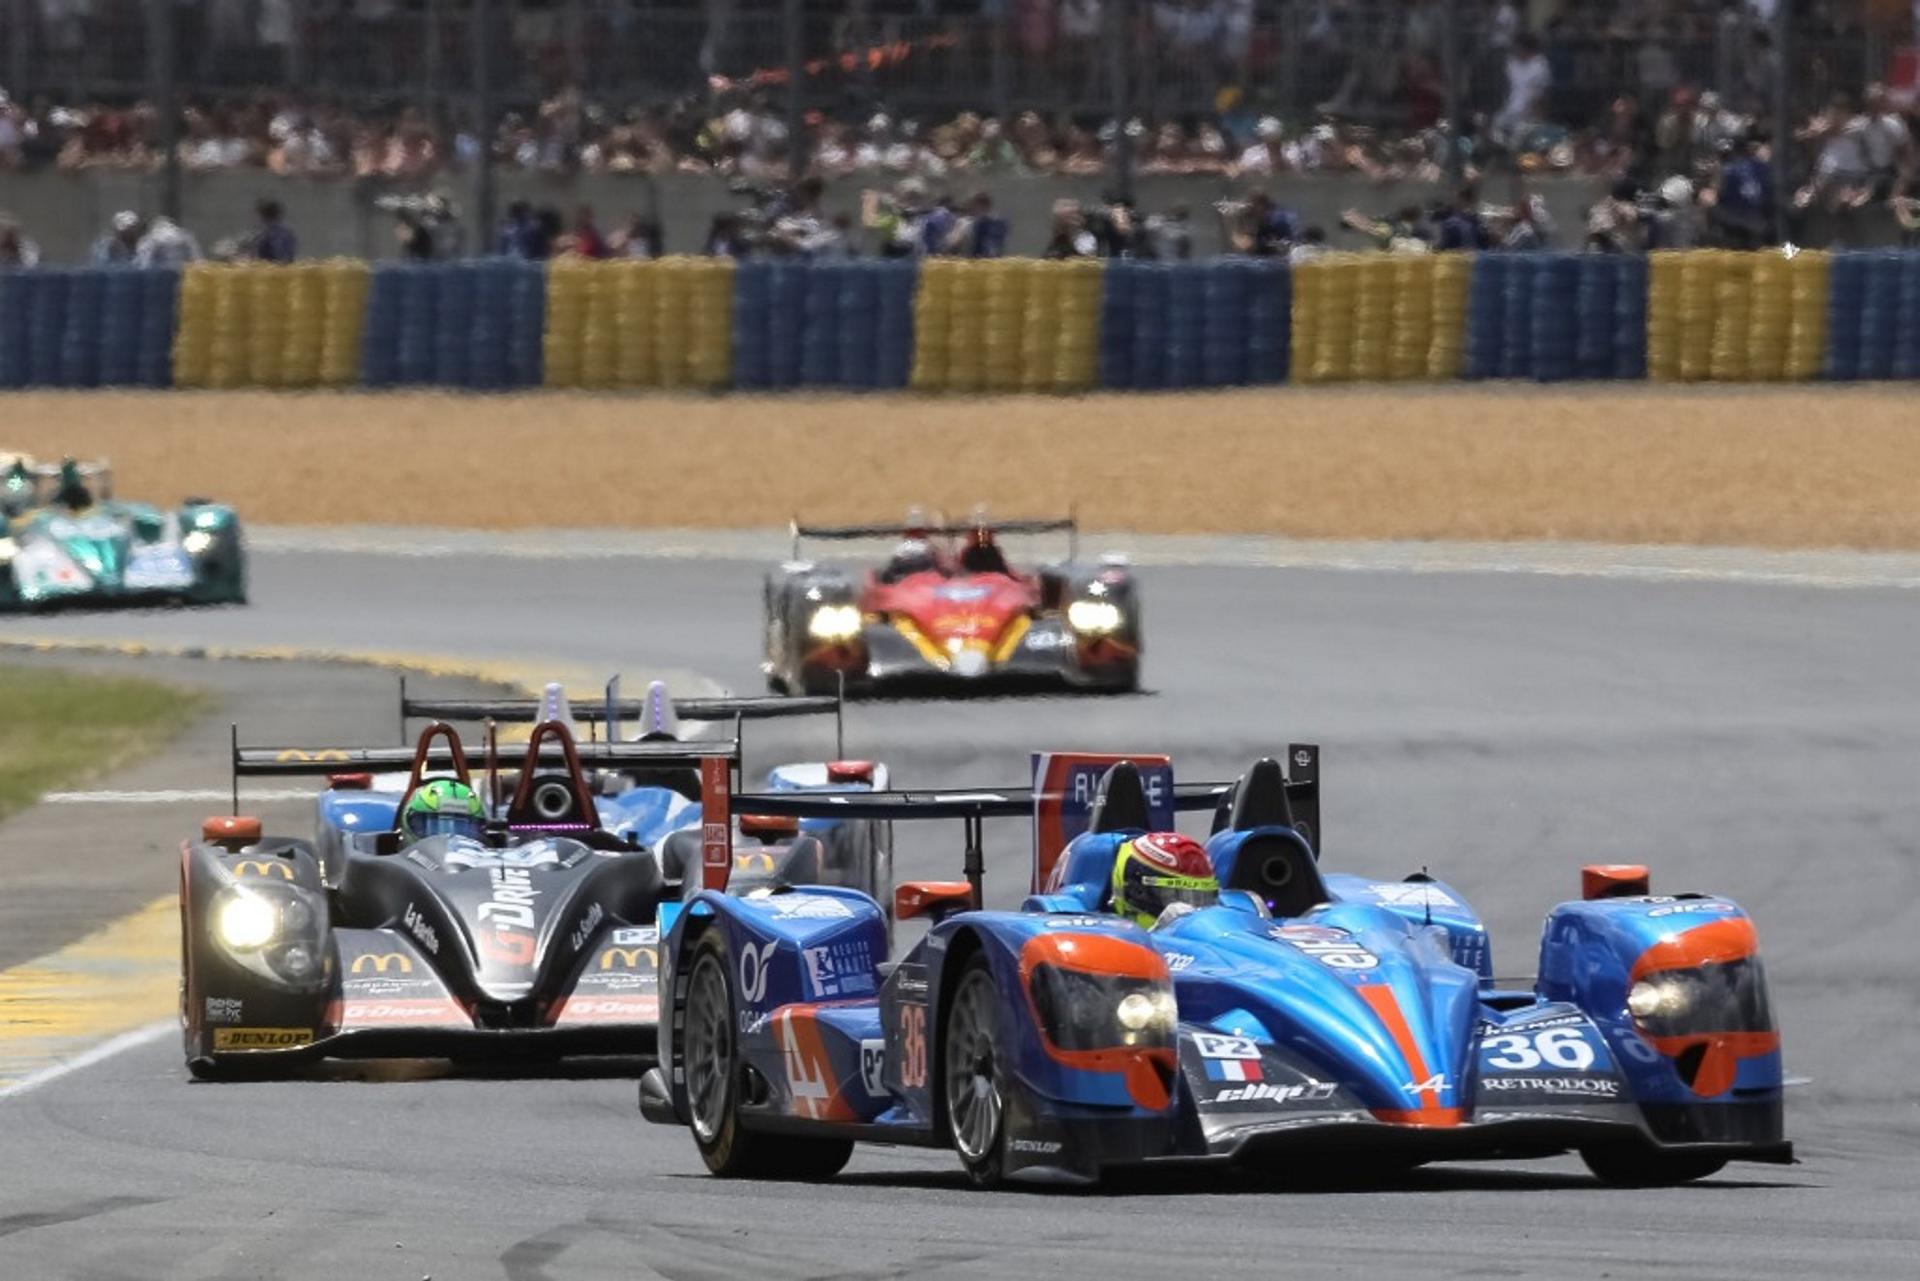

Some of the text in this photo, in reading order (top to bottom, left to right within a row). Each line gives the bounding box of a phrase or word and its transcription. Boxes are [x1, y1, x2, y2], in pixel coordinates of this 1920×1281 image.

[229, 1033, 310, 1045] DUNLOP
[901, 1004, 927, 1088] 36
[1202, 1037, 1253, 1055] P2
[1480, 1027, 1595, 1070] 36
[1482, 1077, 1619, 1093] RETRODOR
